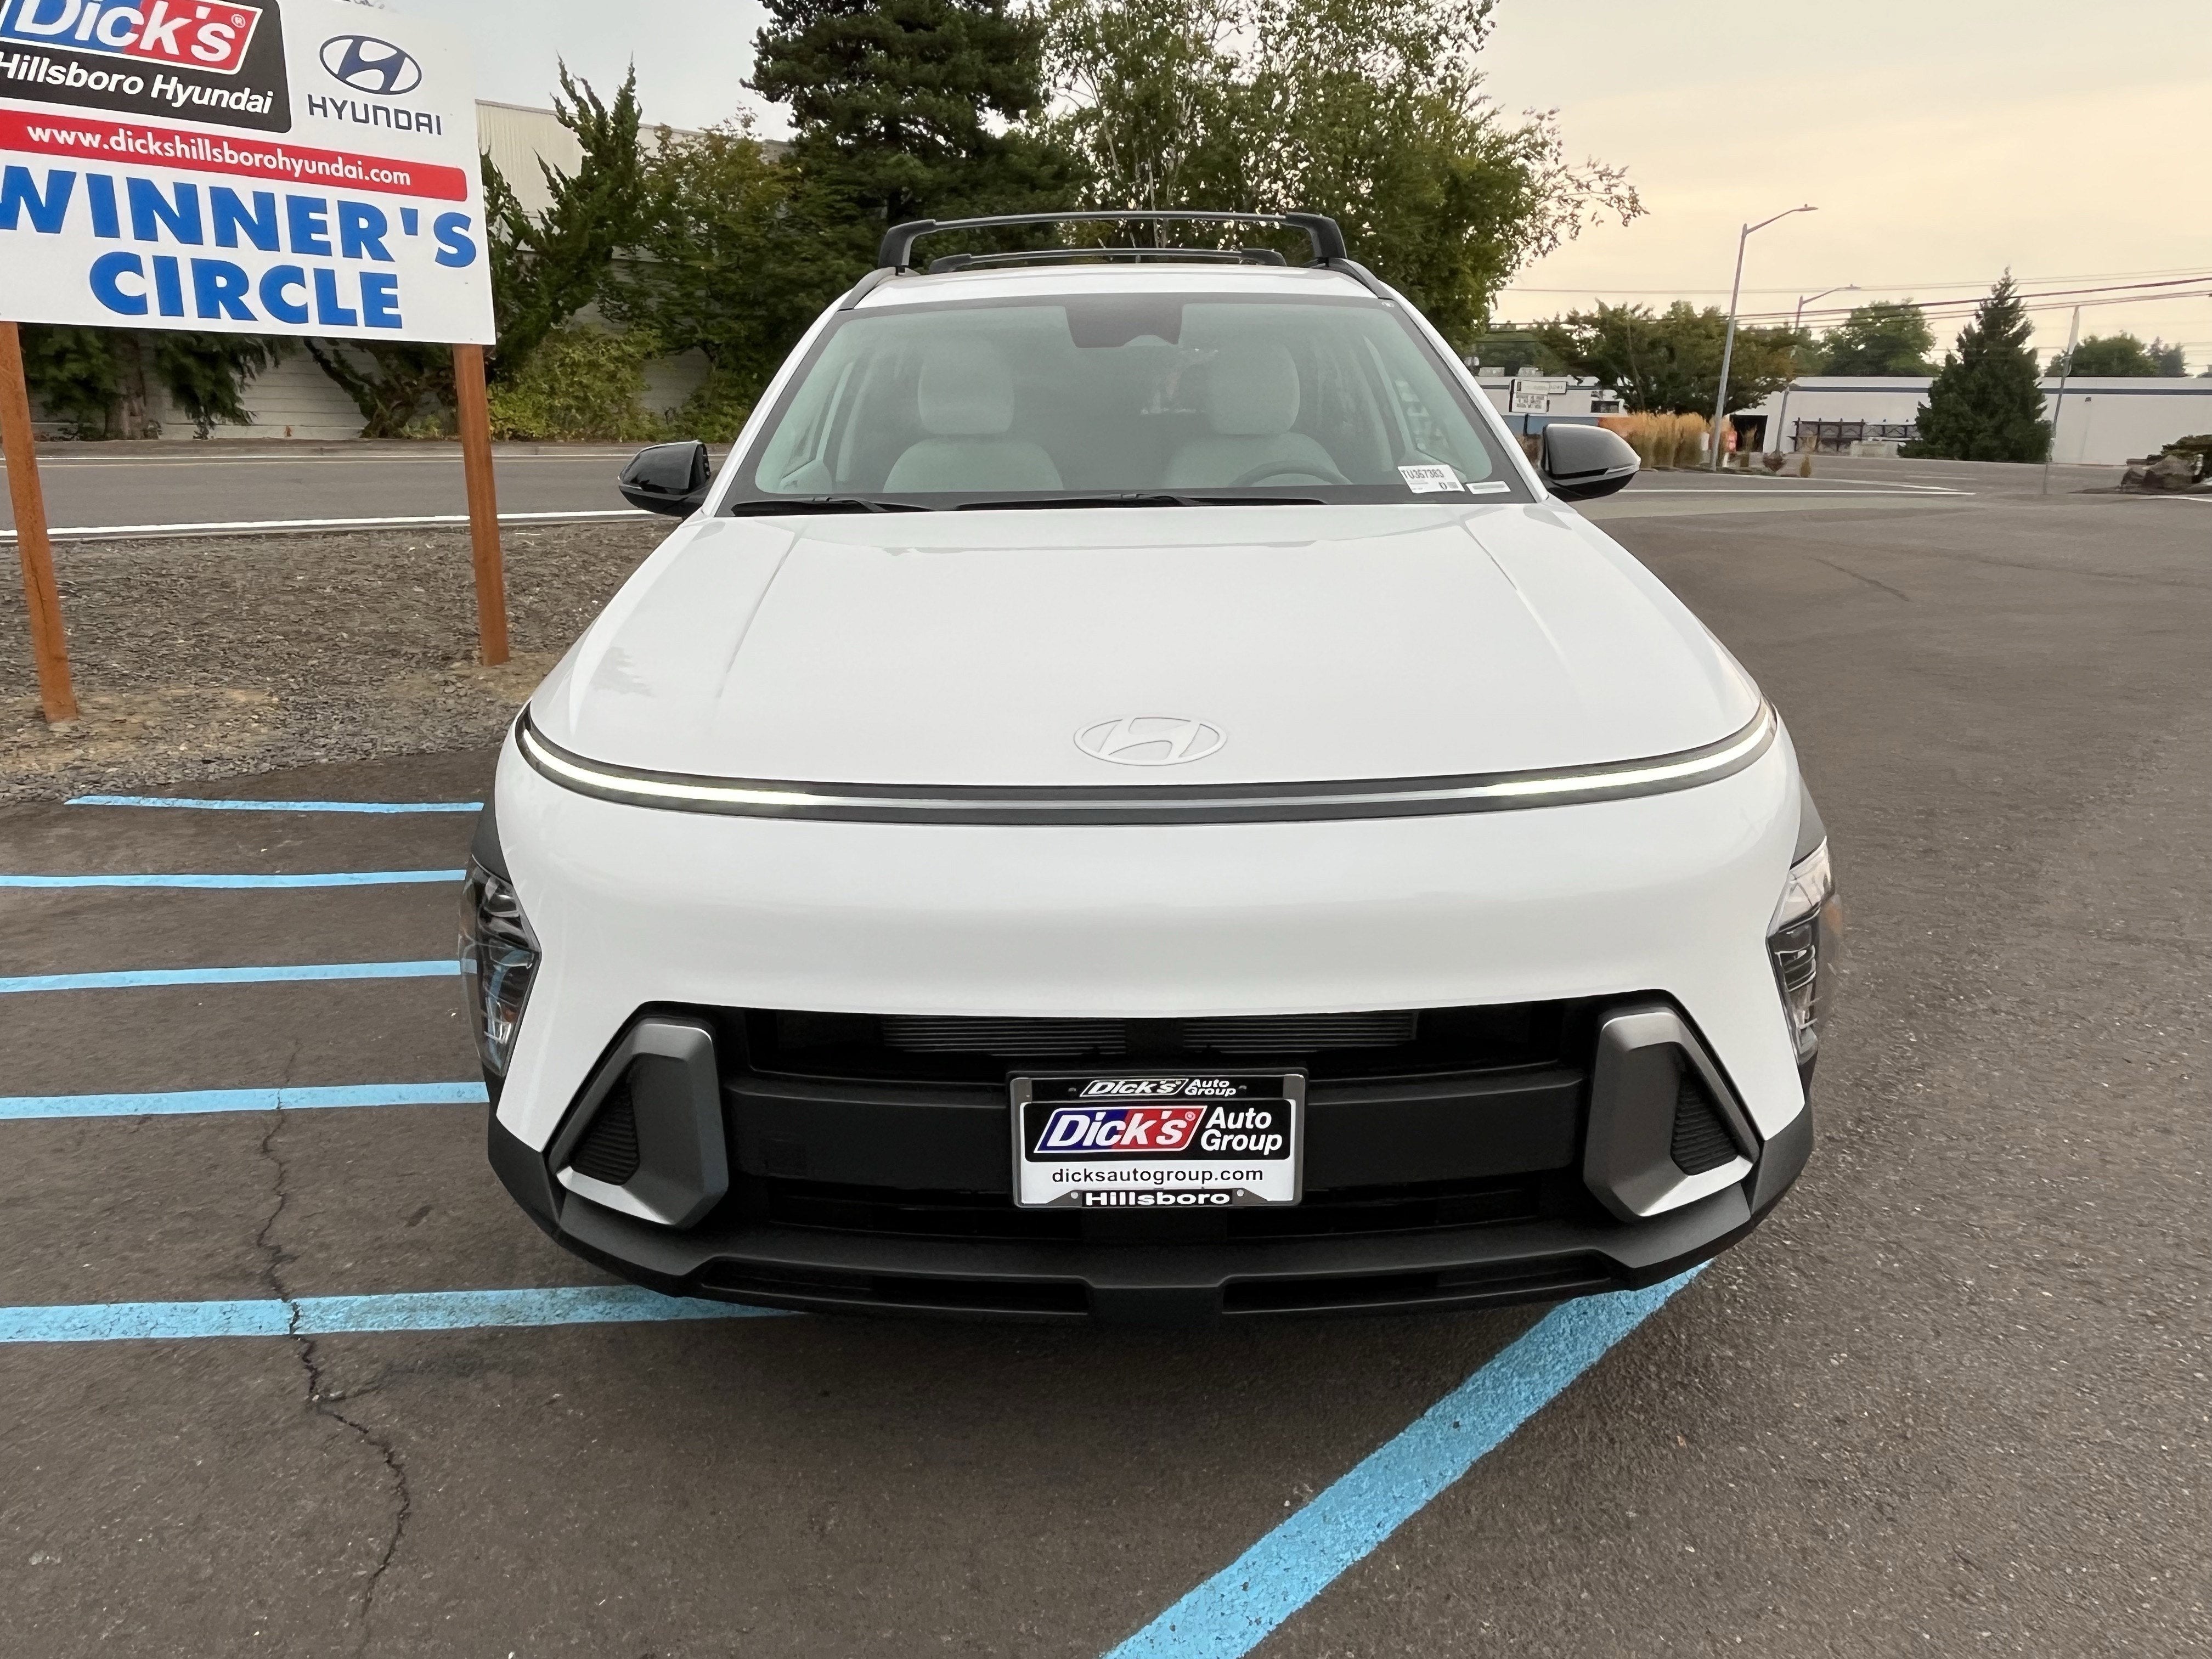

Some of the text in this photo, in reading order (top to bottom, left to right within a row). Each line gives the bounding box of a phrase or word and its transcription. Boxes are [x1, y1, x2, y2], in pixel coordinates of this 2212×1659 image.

[0, 52, 273, 114] Hillsboro Hyundai
[308, 94, 442, 136] HYUNDAI
[27, 125, 411, 187] www.dickshillsborohyundai.com
[0, 165, 477, 268] WINNER'S
[89, 251, 403, 329] CIRCLE
[1184, 1086, 1237, 1097] Group
[1188, 1079, 1230, 1088] Auto
[1205, 1107, 1272, 1129] Auto
[1201, 1129, 1283, 1155] Group
[1052, 1169, 1263, 1185] dicksautogroup.com
[1086, 1192, 1231, 1206] Hillsboro
